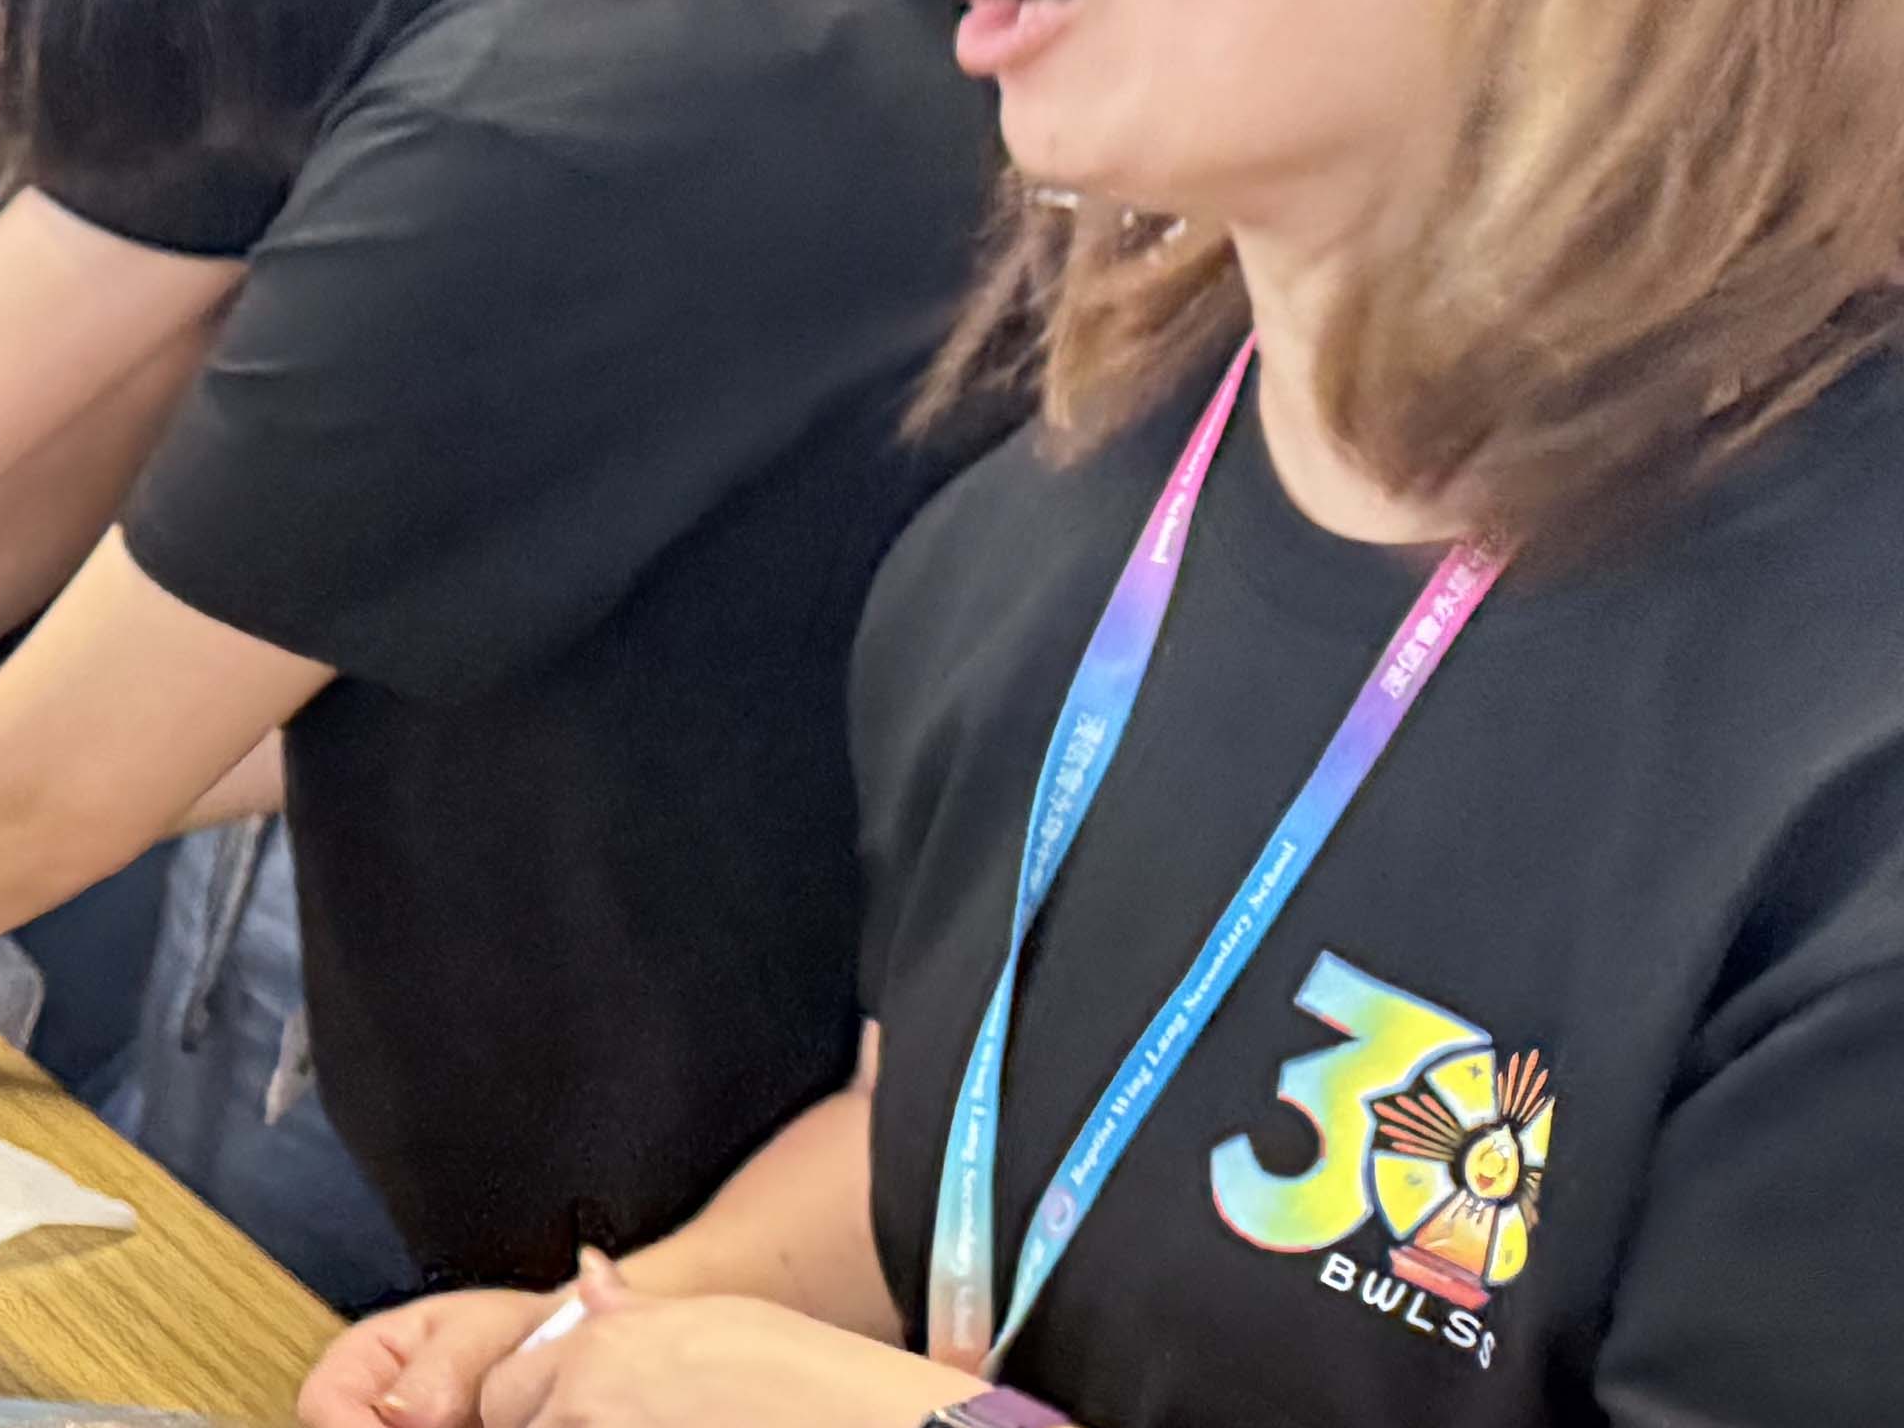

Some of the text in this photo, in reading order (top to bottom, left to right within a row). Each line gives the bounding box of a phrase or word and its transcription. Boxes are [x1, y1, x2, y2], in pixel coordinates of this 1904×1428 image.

[1109, 1061, 1157, 1121] Wing
[1140, 1007, 1192, 1070] Lung
[1244, 838, 1300, 910] School
